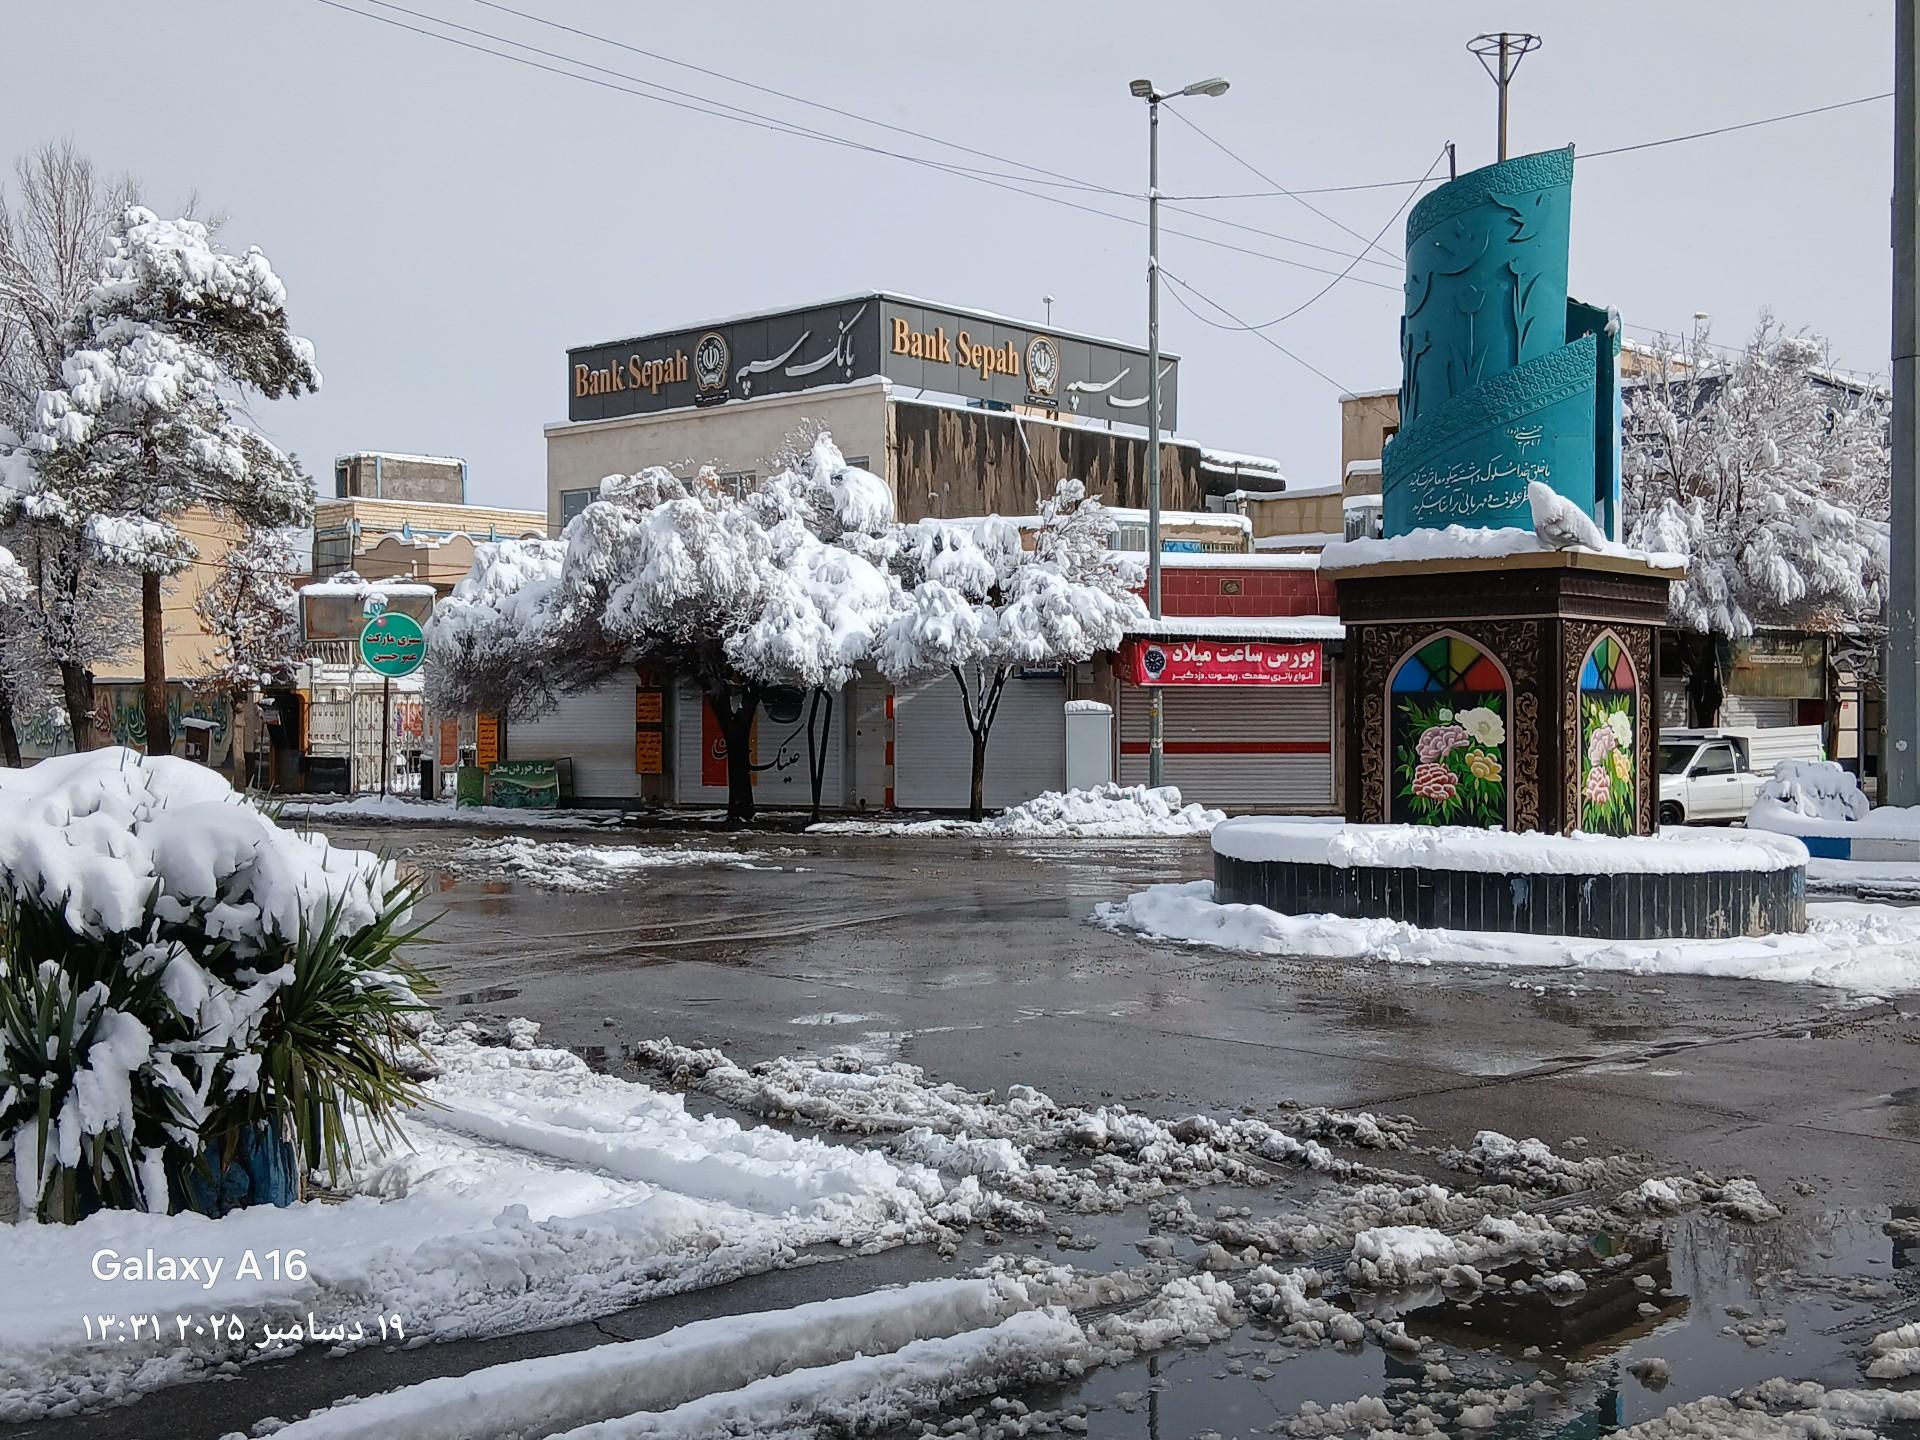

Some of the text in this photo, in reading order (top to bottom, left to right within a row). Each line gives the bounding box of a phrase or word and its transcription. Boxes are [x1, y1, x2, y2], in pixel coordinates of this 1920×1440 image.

[736, 303, 868, 396] بانک سپه
[891, 317, 1020, 380] Bank Sepah
[575, 349, 689, 397] Bank Sepah
[1064, 367, 1131, 412] سپه
[1516, 462, 1530, 478] خدا
[1527, 460, 1545, 482] خلق
[365, 632, 395, 646] مارکت
[372, 652, 399, 662] حسین
[1172, 643, 1315, 668] بورس ساعت میلاد
[1208, 672, 1238, 682] ریموت
[1270, 672, 1293, 682] باتری
[1293, 671, 1314, 683] انواع
[748, 723, 804, 783] عینک
[489, 763, 508, 776] محلی
[509, 762, 534, 776] خوردن
